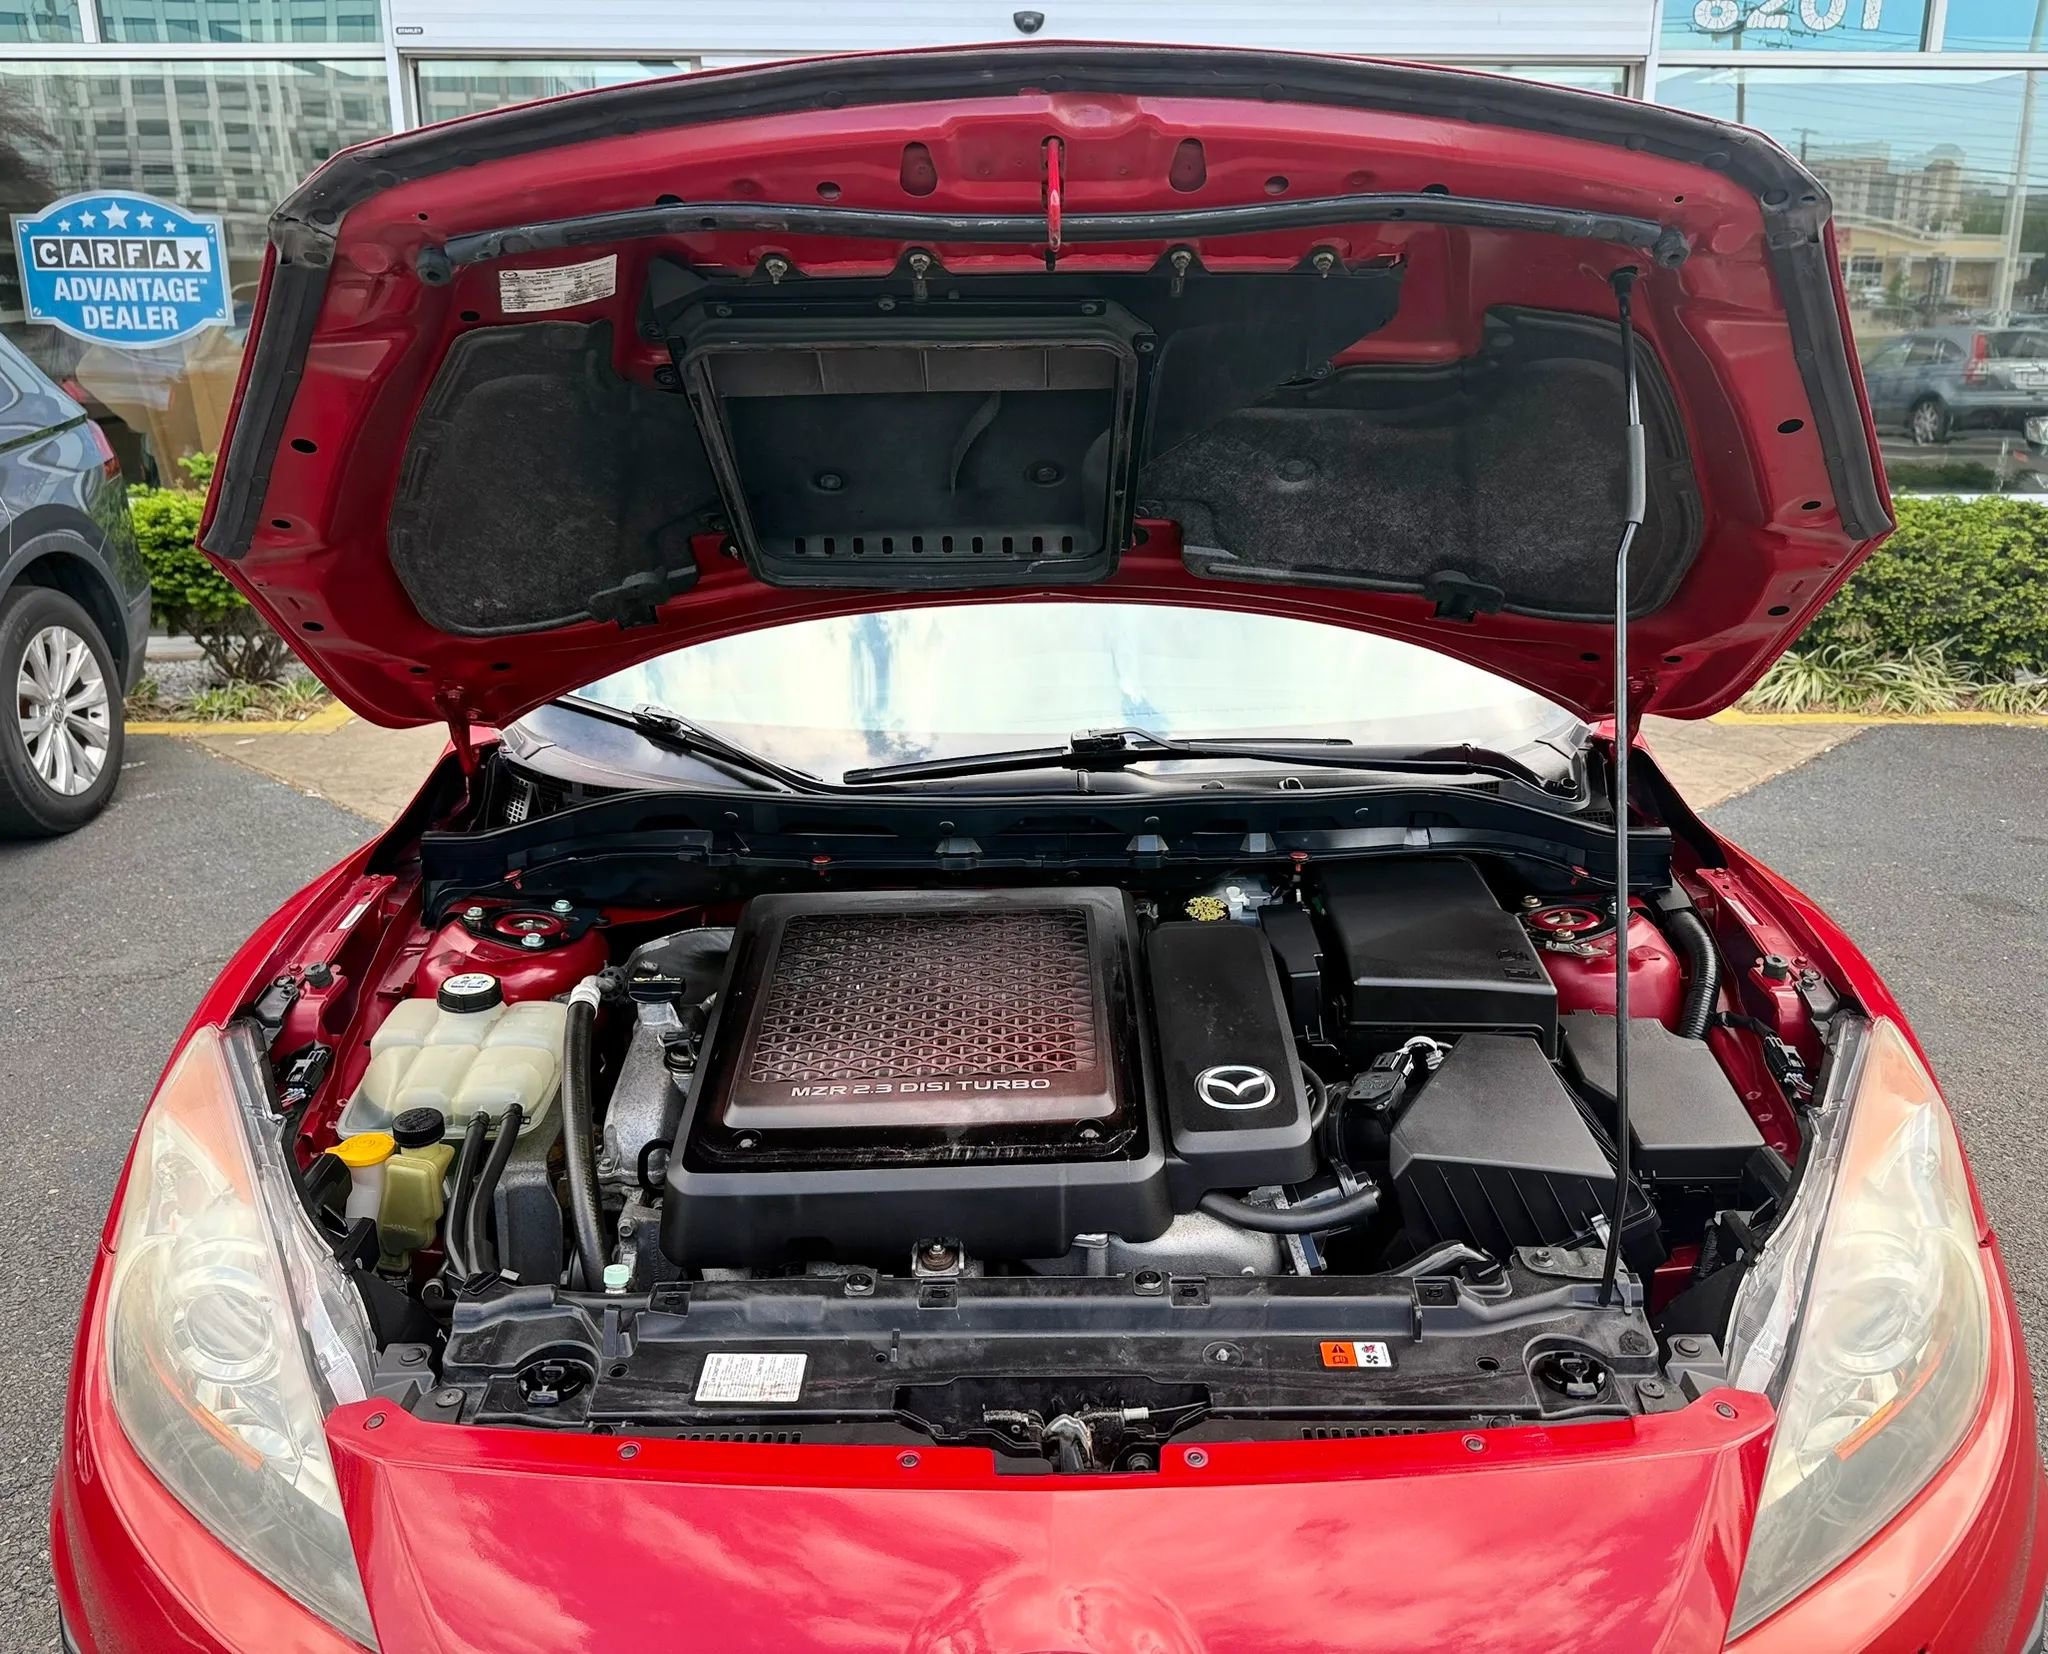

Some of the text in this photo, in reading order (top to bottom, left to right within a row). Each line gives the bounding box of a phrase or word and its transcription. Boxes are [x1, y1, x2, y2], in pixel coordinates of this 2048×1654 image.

[38, 242, 204, 270] CARFAX
[82, 305, 180, 330] DEALER
[791, 1079, 1051, 1097] MZR 2.3 DISI TURBO
